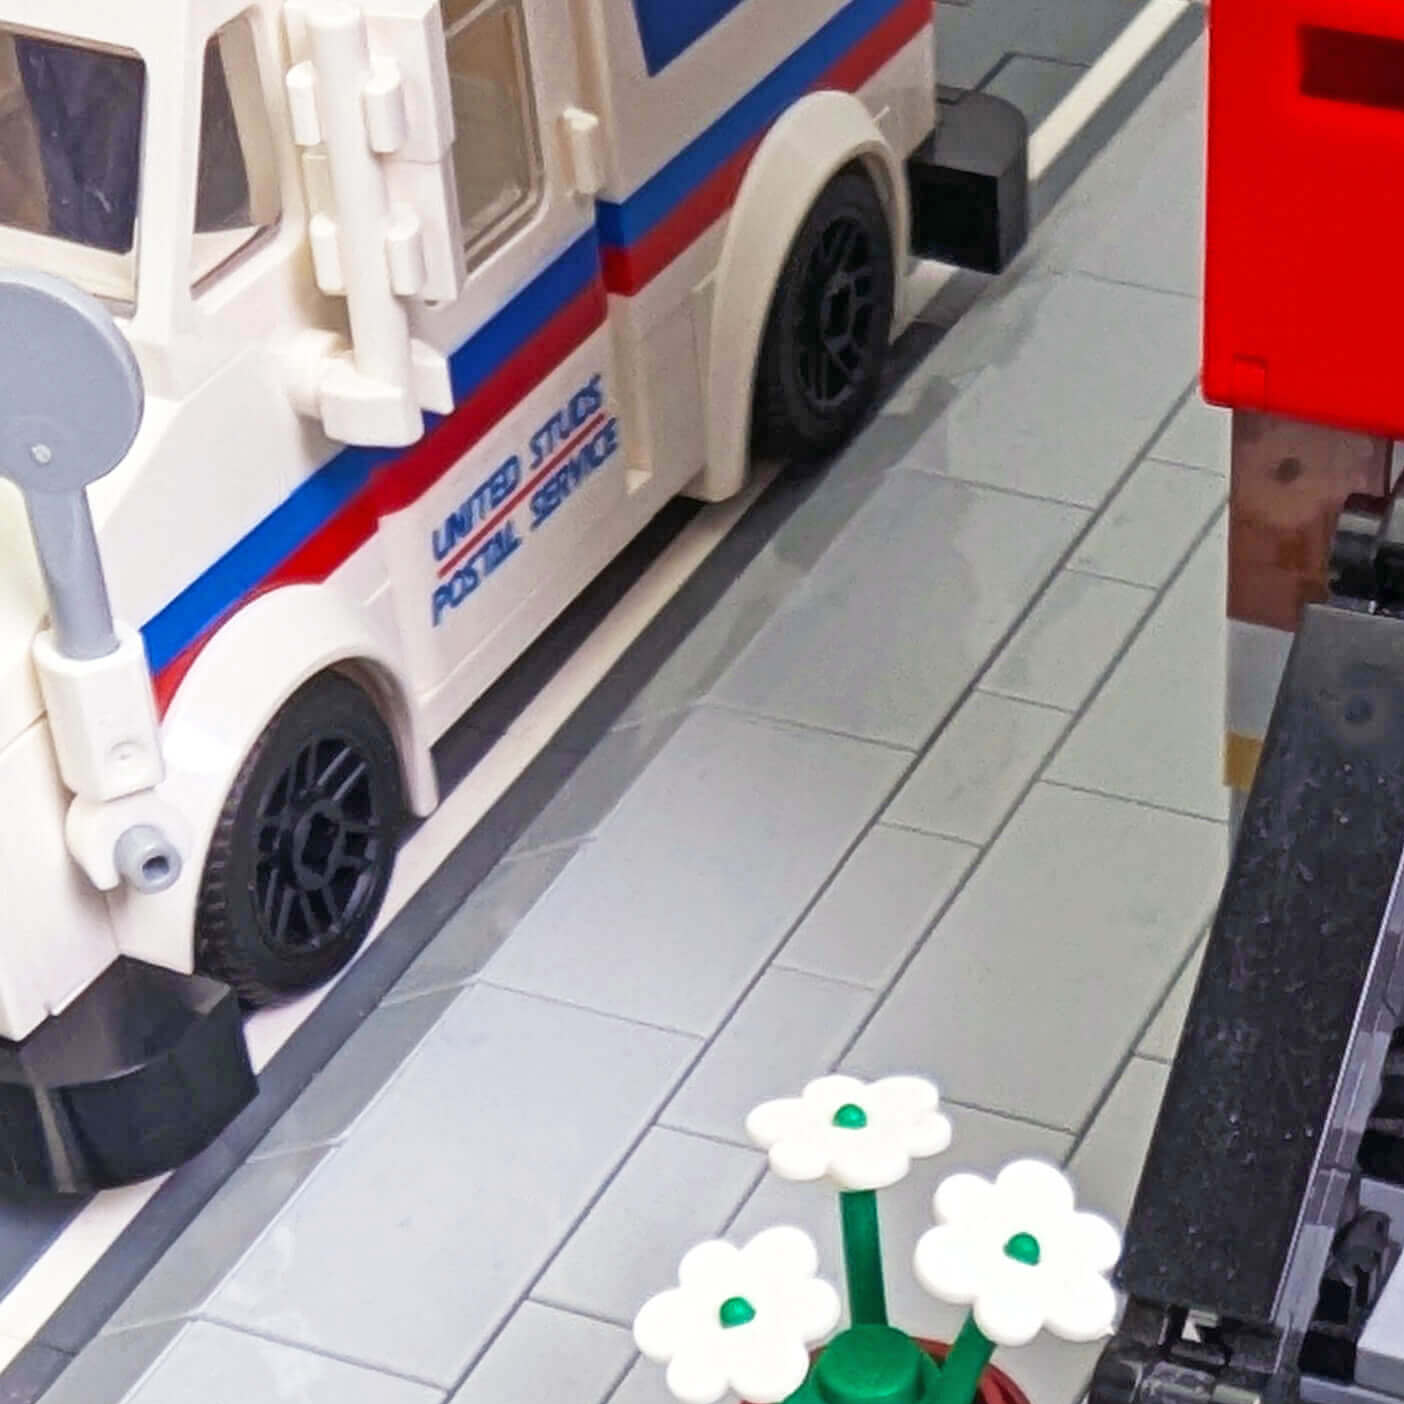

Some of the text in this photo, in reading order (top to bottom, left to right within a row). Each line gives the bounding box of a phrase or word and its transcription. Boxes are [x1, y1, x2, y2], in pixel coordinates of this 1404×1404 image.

[432, 373, 603, 561] UNITED STUDS
[432, 416, 620, 627] POSTAL SERVICE
